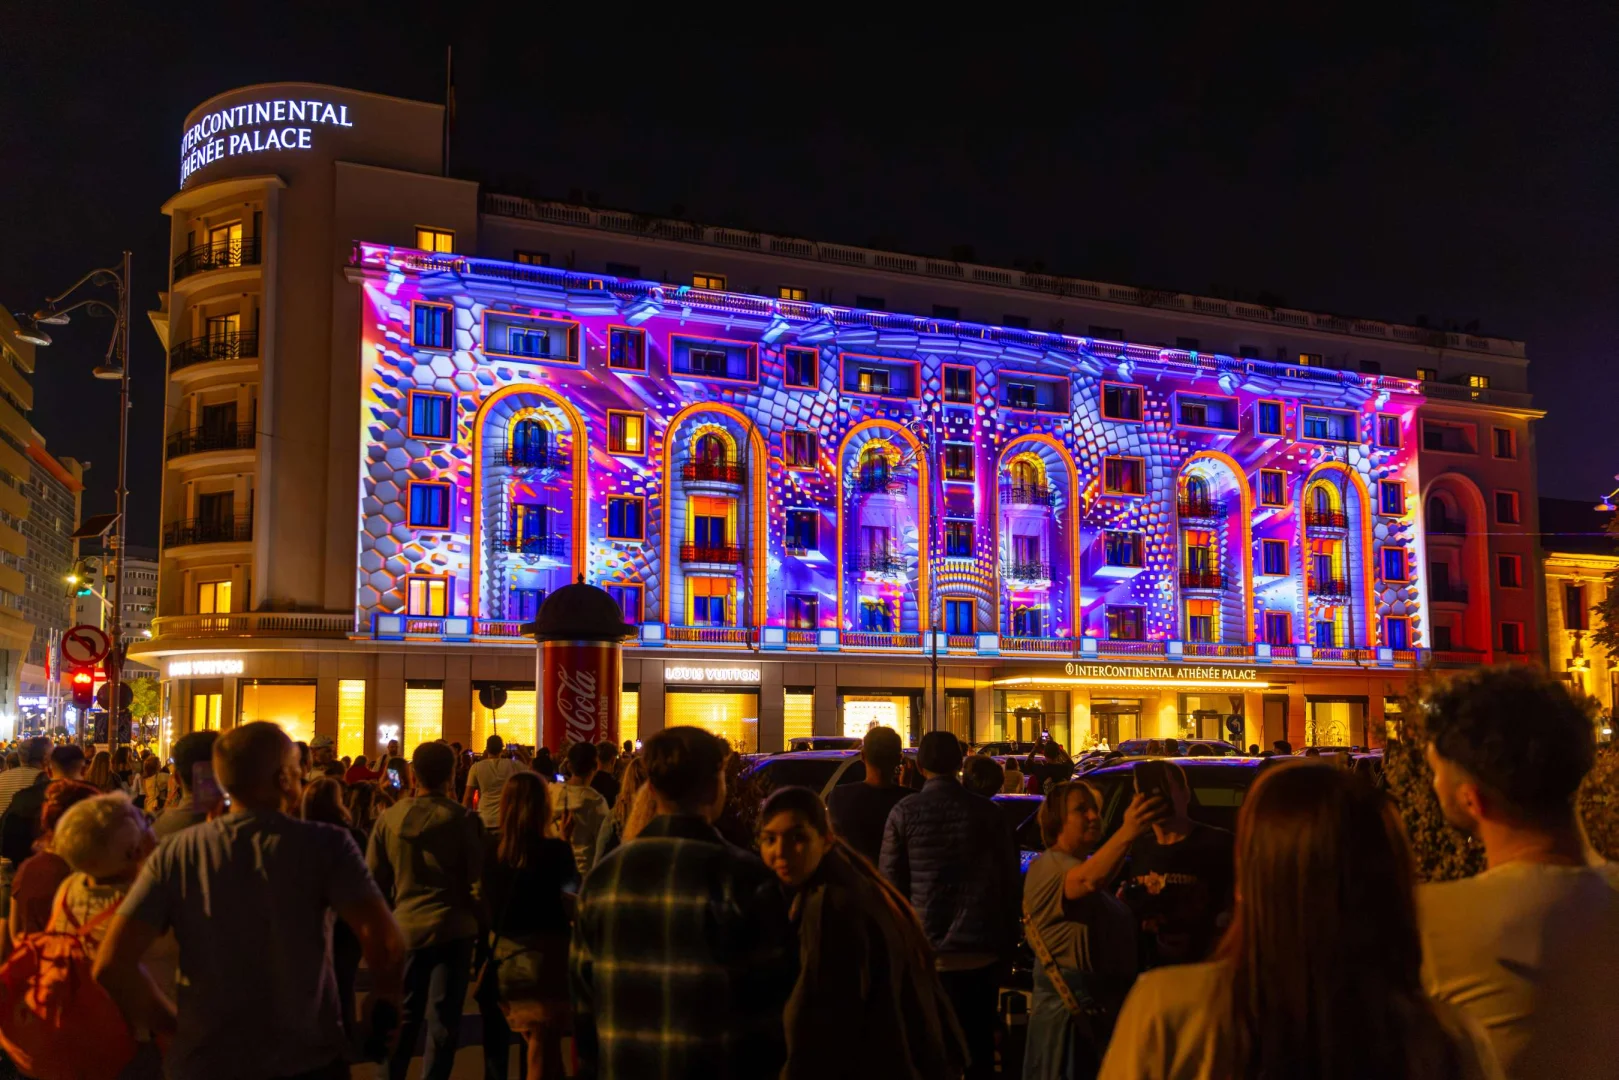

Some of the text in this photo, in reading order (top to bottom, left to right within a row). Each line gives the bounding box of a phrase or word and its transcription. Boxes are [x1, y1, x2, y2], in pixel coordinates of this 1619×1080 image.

[229, 127, 312, 156] PALACE
[665, 668, 759, 681] LOUIS VUITTON
[1177, 666, 1220, 679] ATHÉNÉE
[1222, 669, 1256, 680] PALACE
